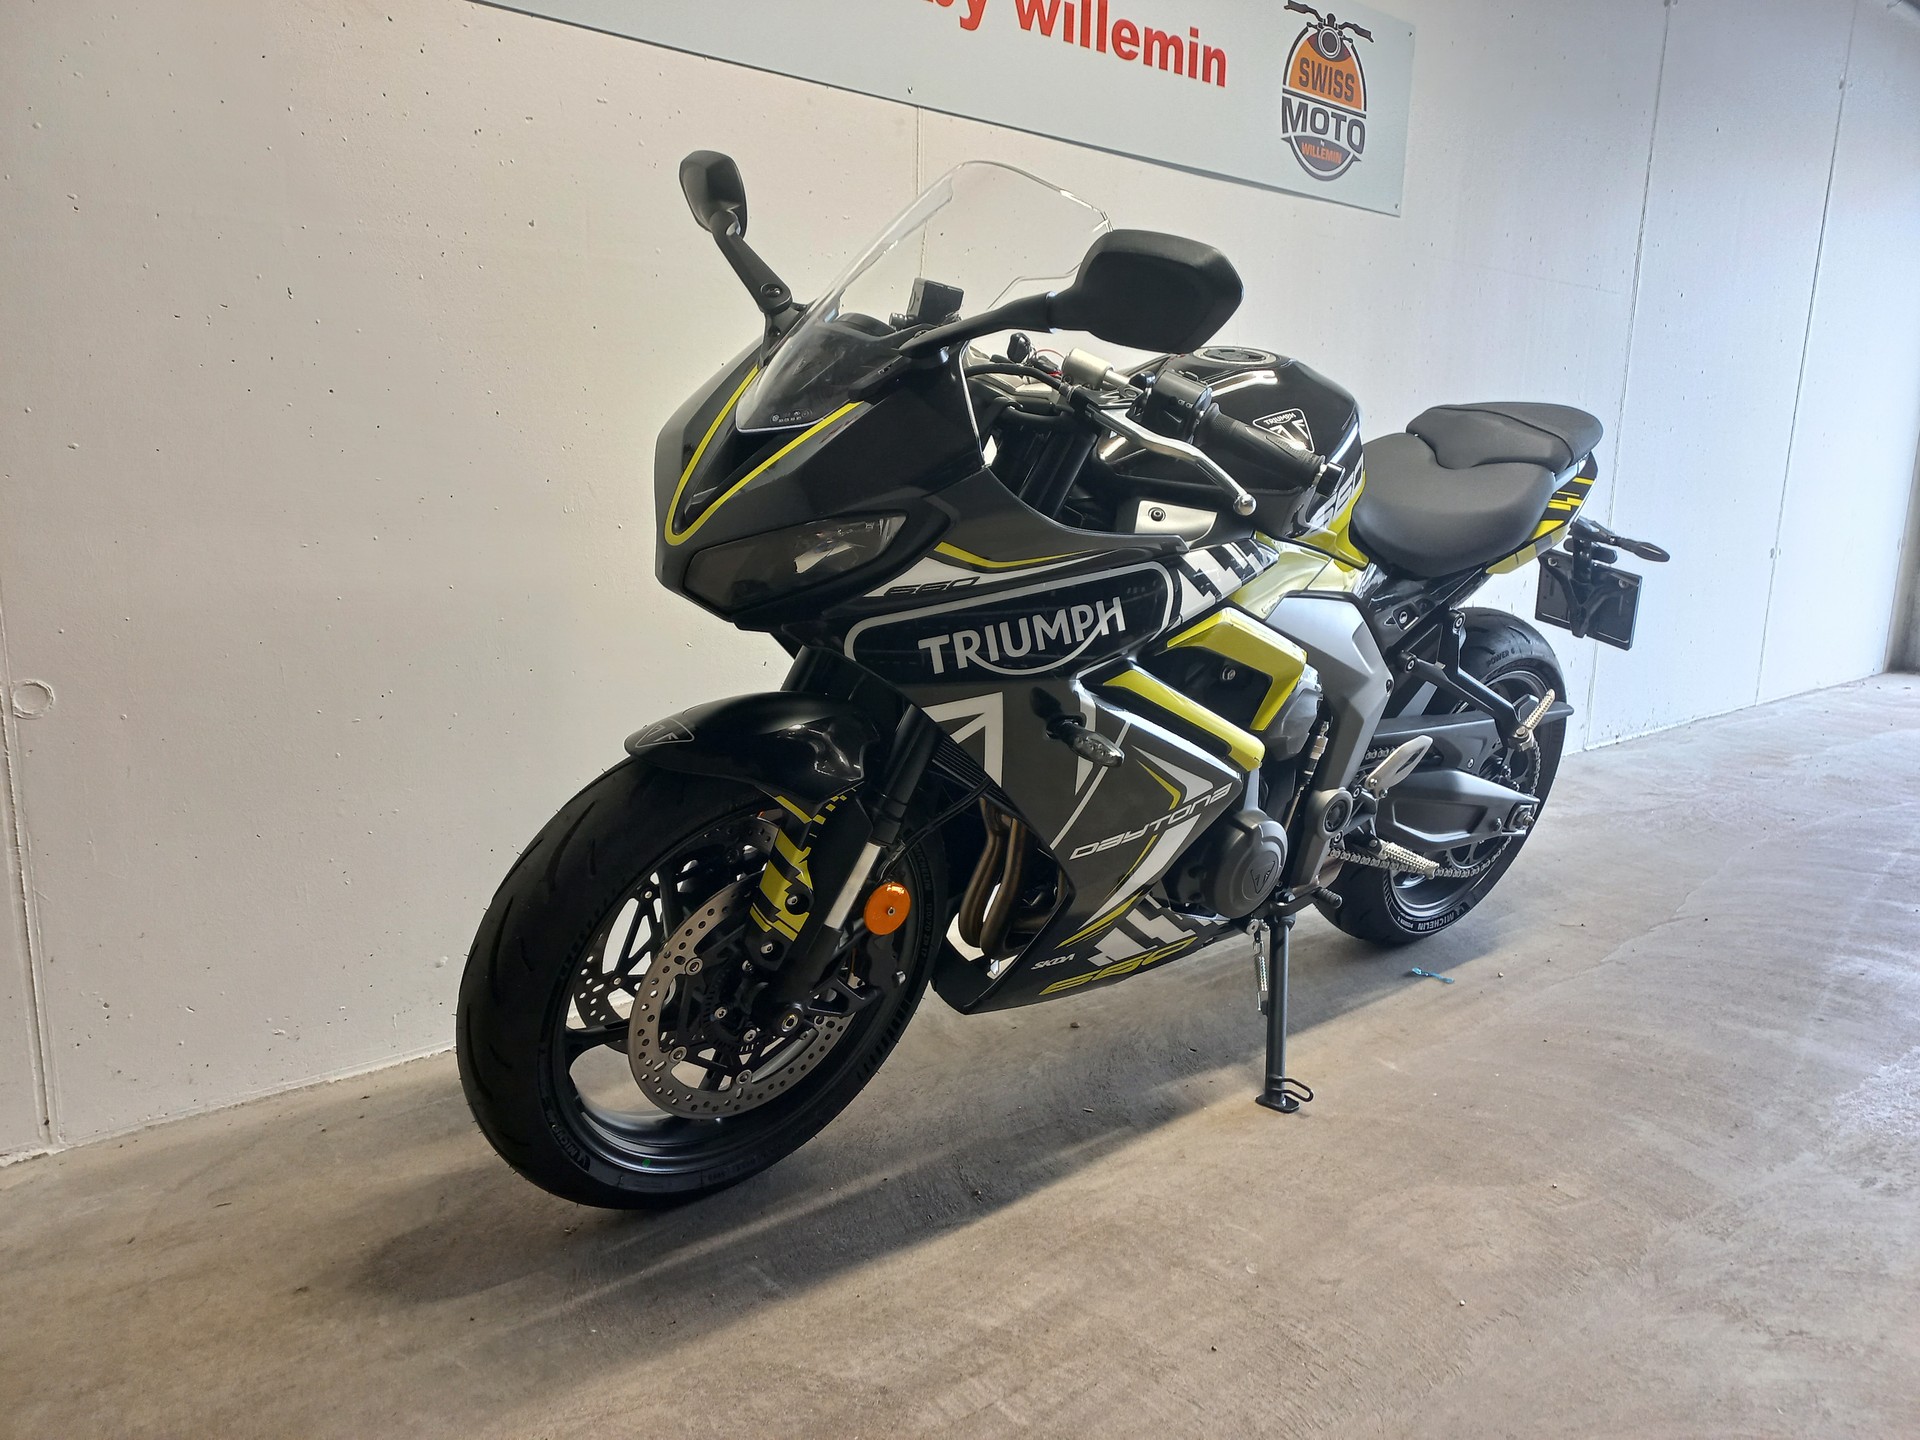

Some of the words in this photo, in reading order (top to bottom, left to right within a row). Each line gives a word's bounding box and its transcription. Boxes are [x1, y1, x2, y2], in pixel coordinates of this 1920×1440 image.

[1298, 57, 1355, 102] SWISS
[1281, 95, 1366, 154] MOTO
[1301, 141, 1343, 165] WILLEMIN
[1263, 412, 1297, 426] TRIUMPH
[883, 576, 981, 597] 660
[917, 596, 1126, 676] TRIUMPH
[1030, 952, 1076, 971] SKDA
[1038, 936, 1199, 996] 660
